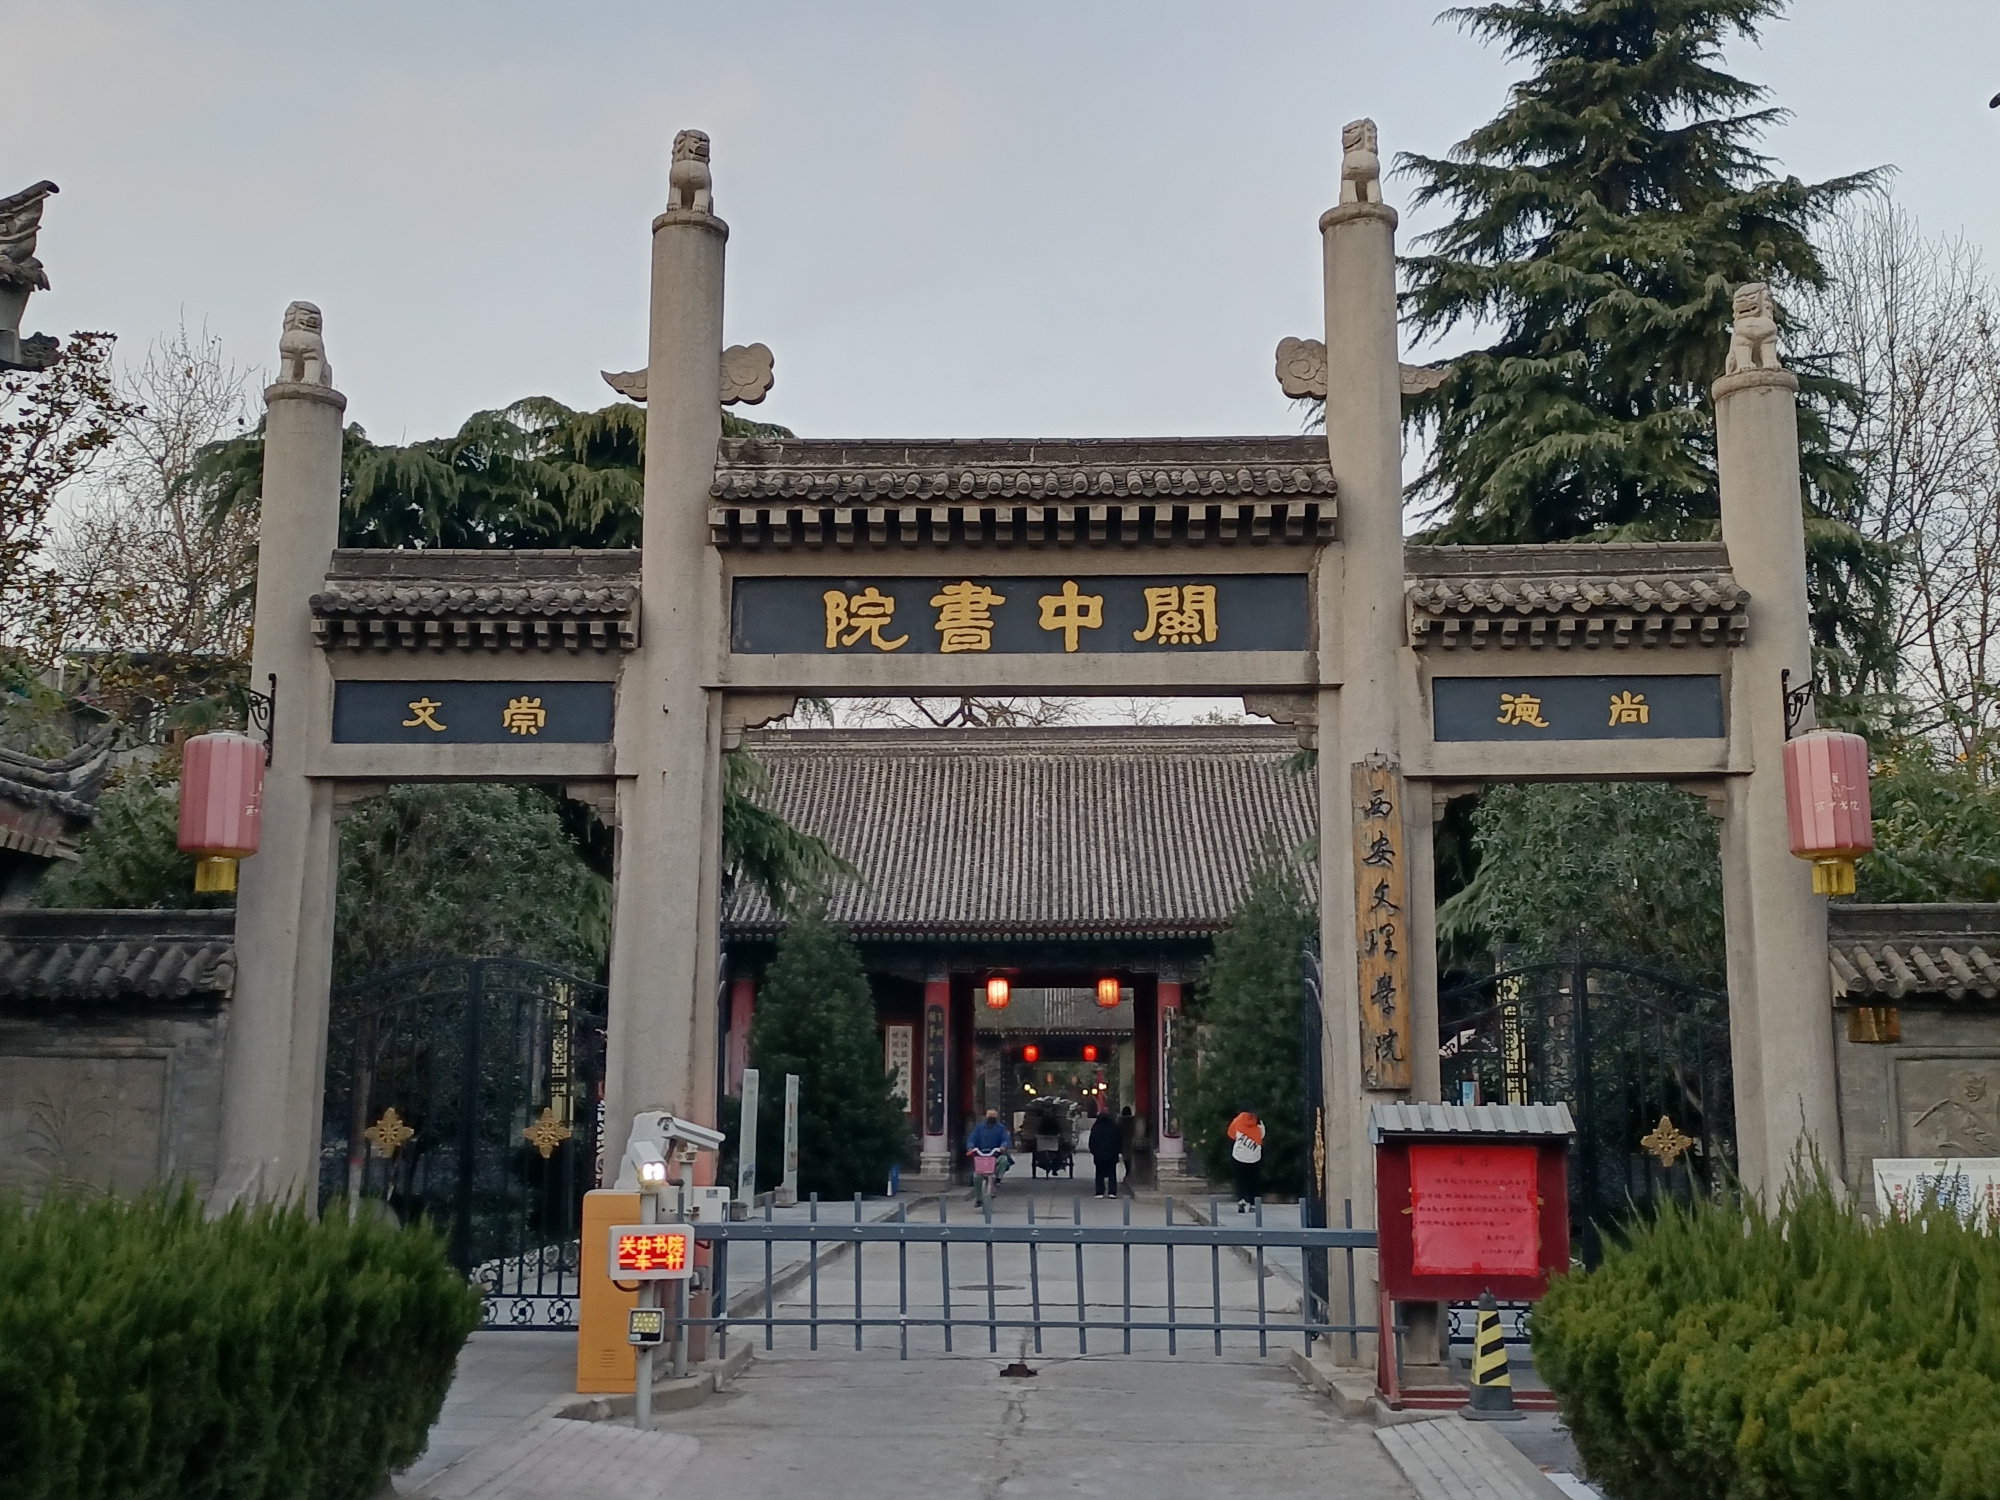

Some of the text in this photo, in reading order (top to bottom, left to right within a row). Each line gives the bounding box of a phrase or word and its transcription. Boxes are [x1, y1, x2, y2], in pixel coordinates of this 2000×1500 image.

[402, 695, 547, 736] 崇文
[618, 1235, 685, 1254] 关中书院
[618, 1253, 684, 1271] 一车一杆
